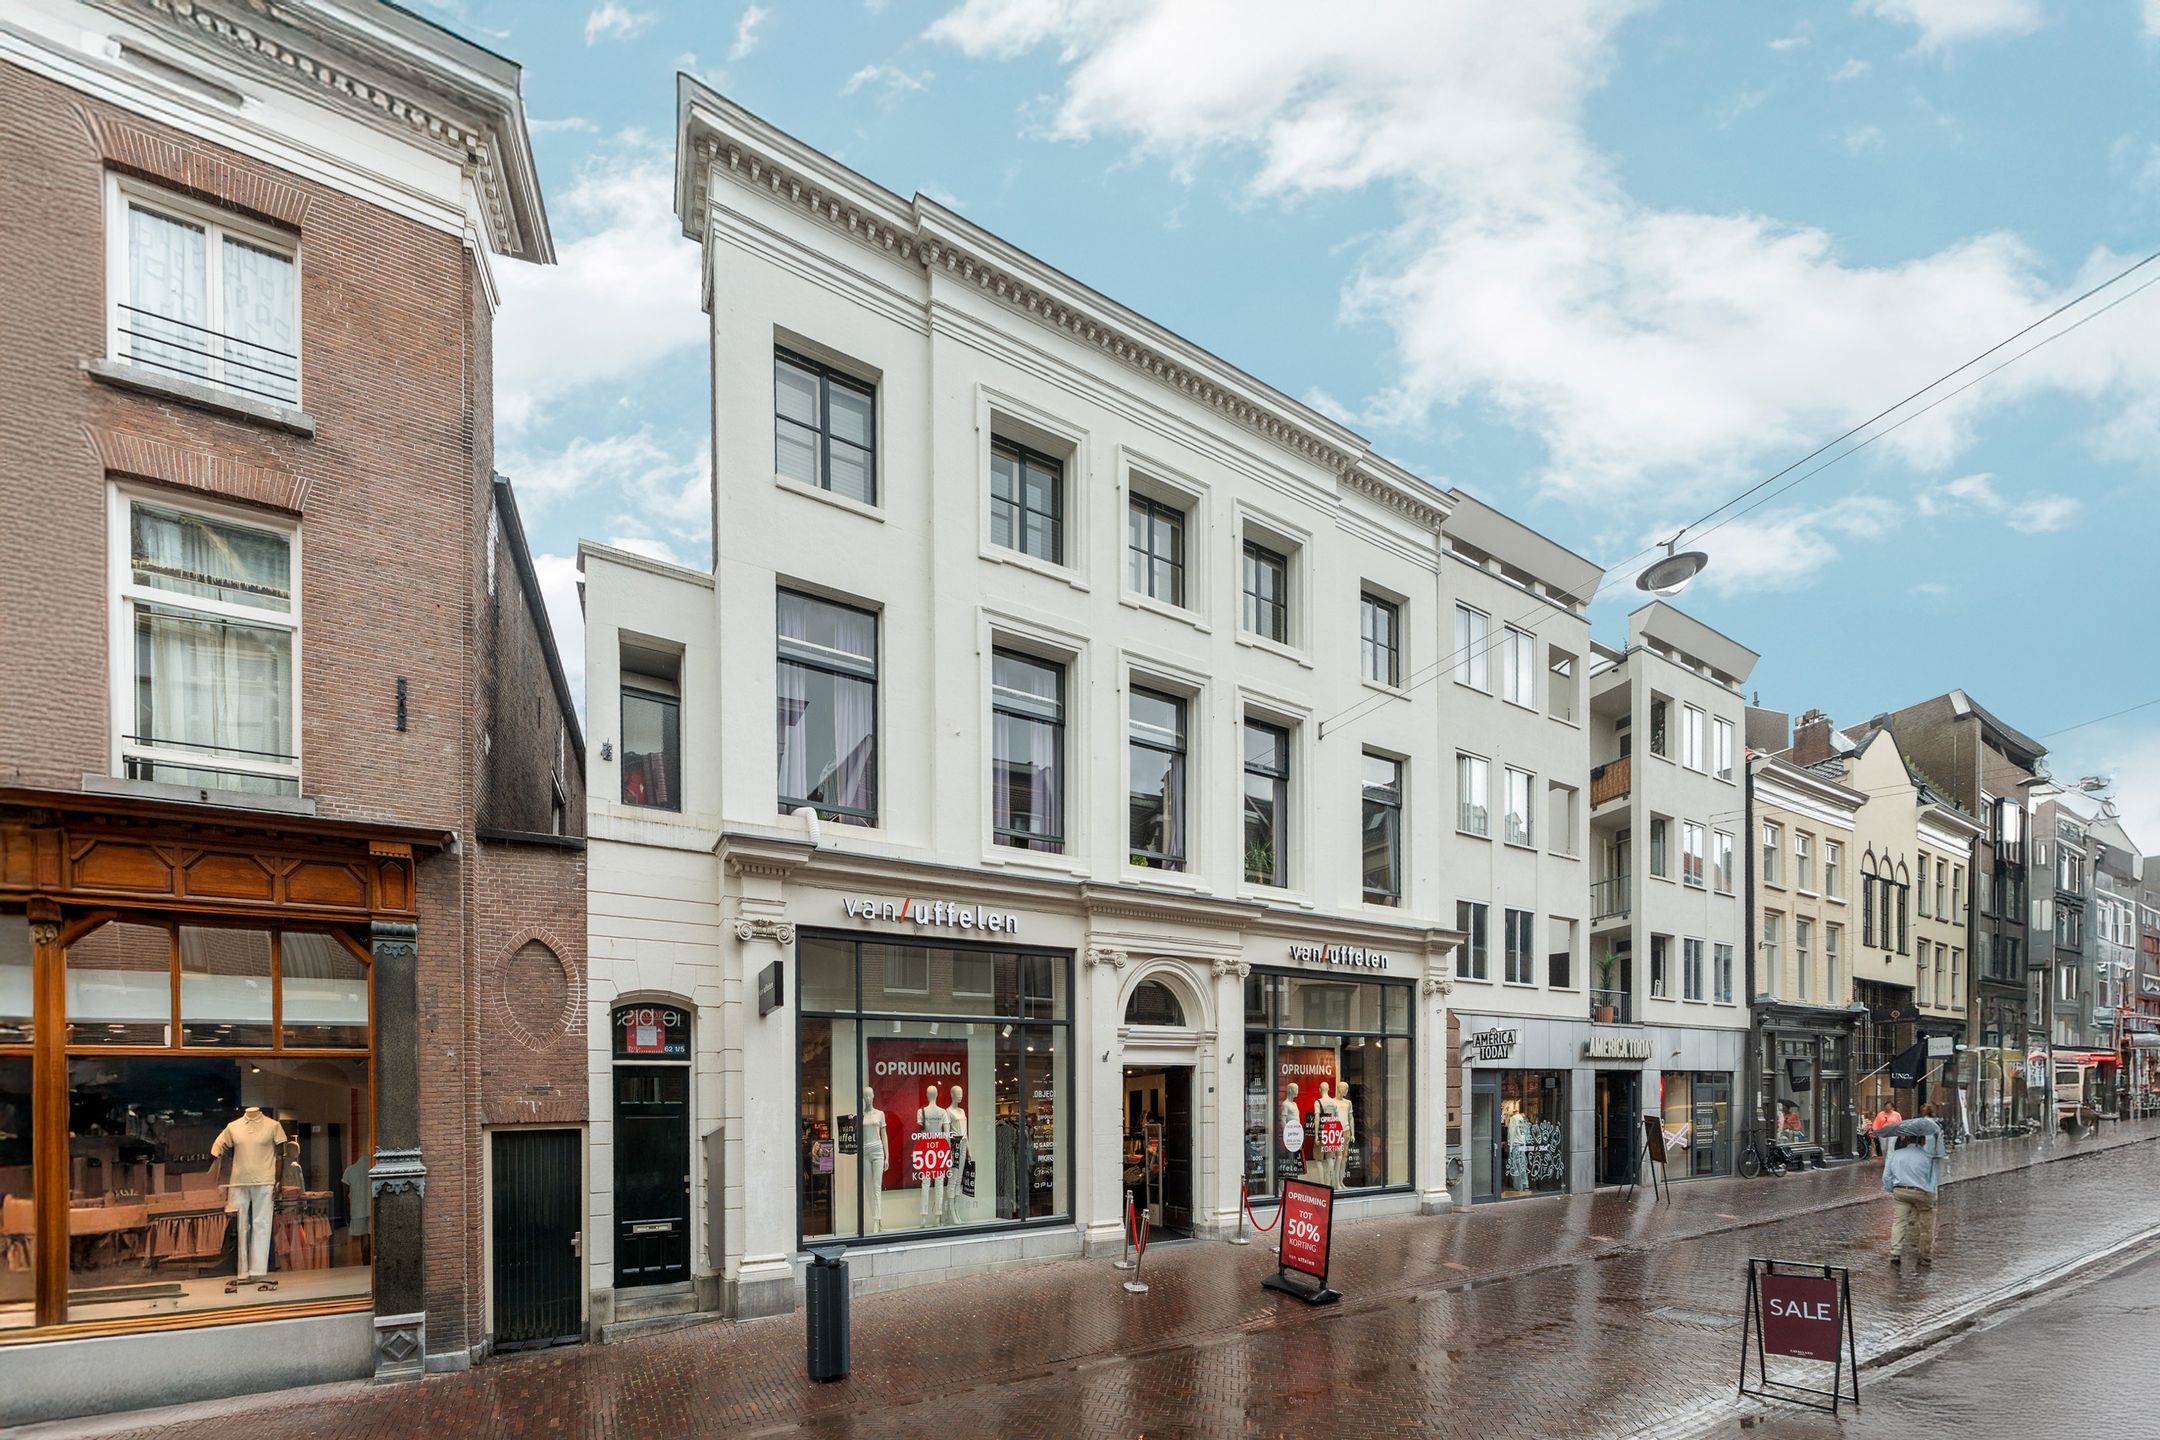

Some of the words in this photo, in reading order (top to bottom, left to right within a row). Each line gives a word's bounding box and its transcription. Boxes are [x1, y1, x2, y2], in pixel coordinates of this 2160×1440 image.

[1475, 1031, 1514, 1046] AMERICA
[1481, 1044, 1508, 1059] TODAY
[1589, 1037, 1628, 1058] AMERICA
[1628, 1039, 1654, 1058] TODAY
[875, 1061, 961, 1076] OPRUIMING
[1281, 1063, 1332, 1076] OPRUIMING
[911, 1131, 953, 1141] OPRUIMING
[1321, 1129, 1345, 1145] 50%
[926, 1141, 939, 1149] TOT
[1320, 1145, 1345, 1153] KORTING
[912, 1149, 954, 1170] 50%
[912, 1169, 954, 1181] KORTING
[1288, 1191, 1327, 1208] OPRUIMING
[1299, 1210, 1313, 1220] TOT
[1288, 1218, 1320, 1243] 50%
[1289, 1237, 1317, 1253] KORTING
[1769, 1298, 1832, 1321] SALE
